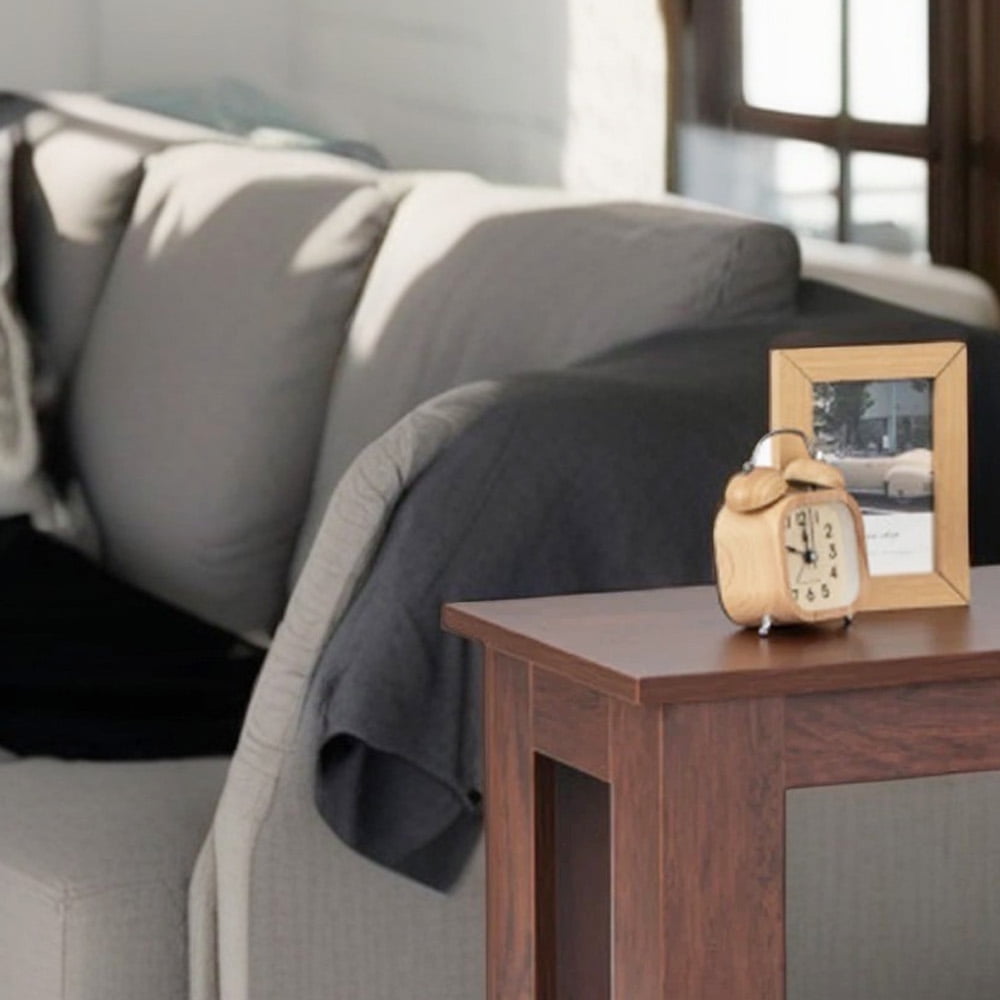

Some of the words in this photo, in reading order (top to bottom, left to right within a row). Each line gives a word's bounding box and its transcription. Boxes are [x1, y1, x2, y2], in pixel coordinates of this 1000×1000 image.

[823, 522, 833, 539] 2
[829, 543, 838, 559] 3
[830, 565, 838, 578] 4
[792, 588, 799, 601] 7
[806, 587, 815, 602] 6
[821, 583, 831, 599] 5
